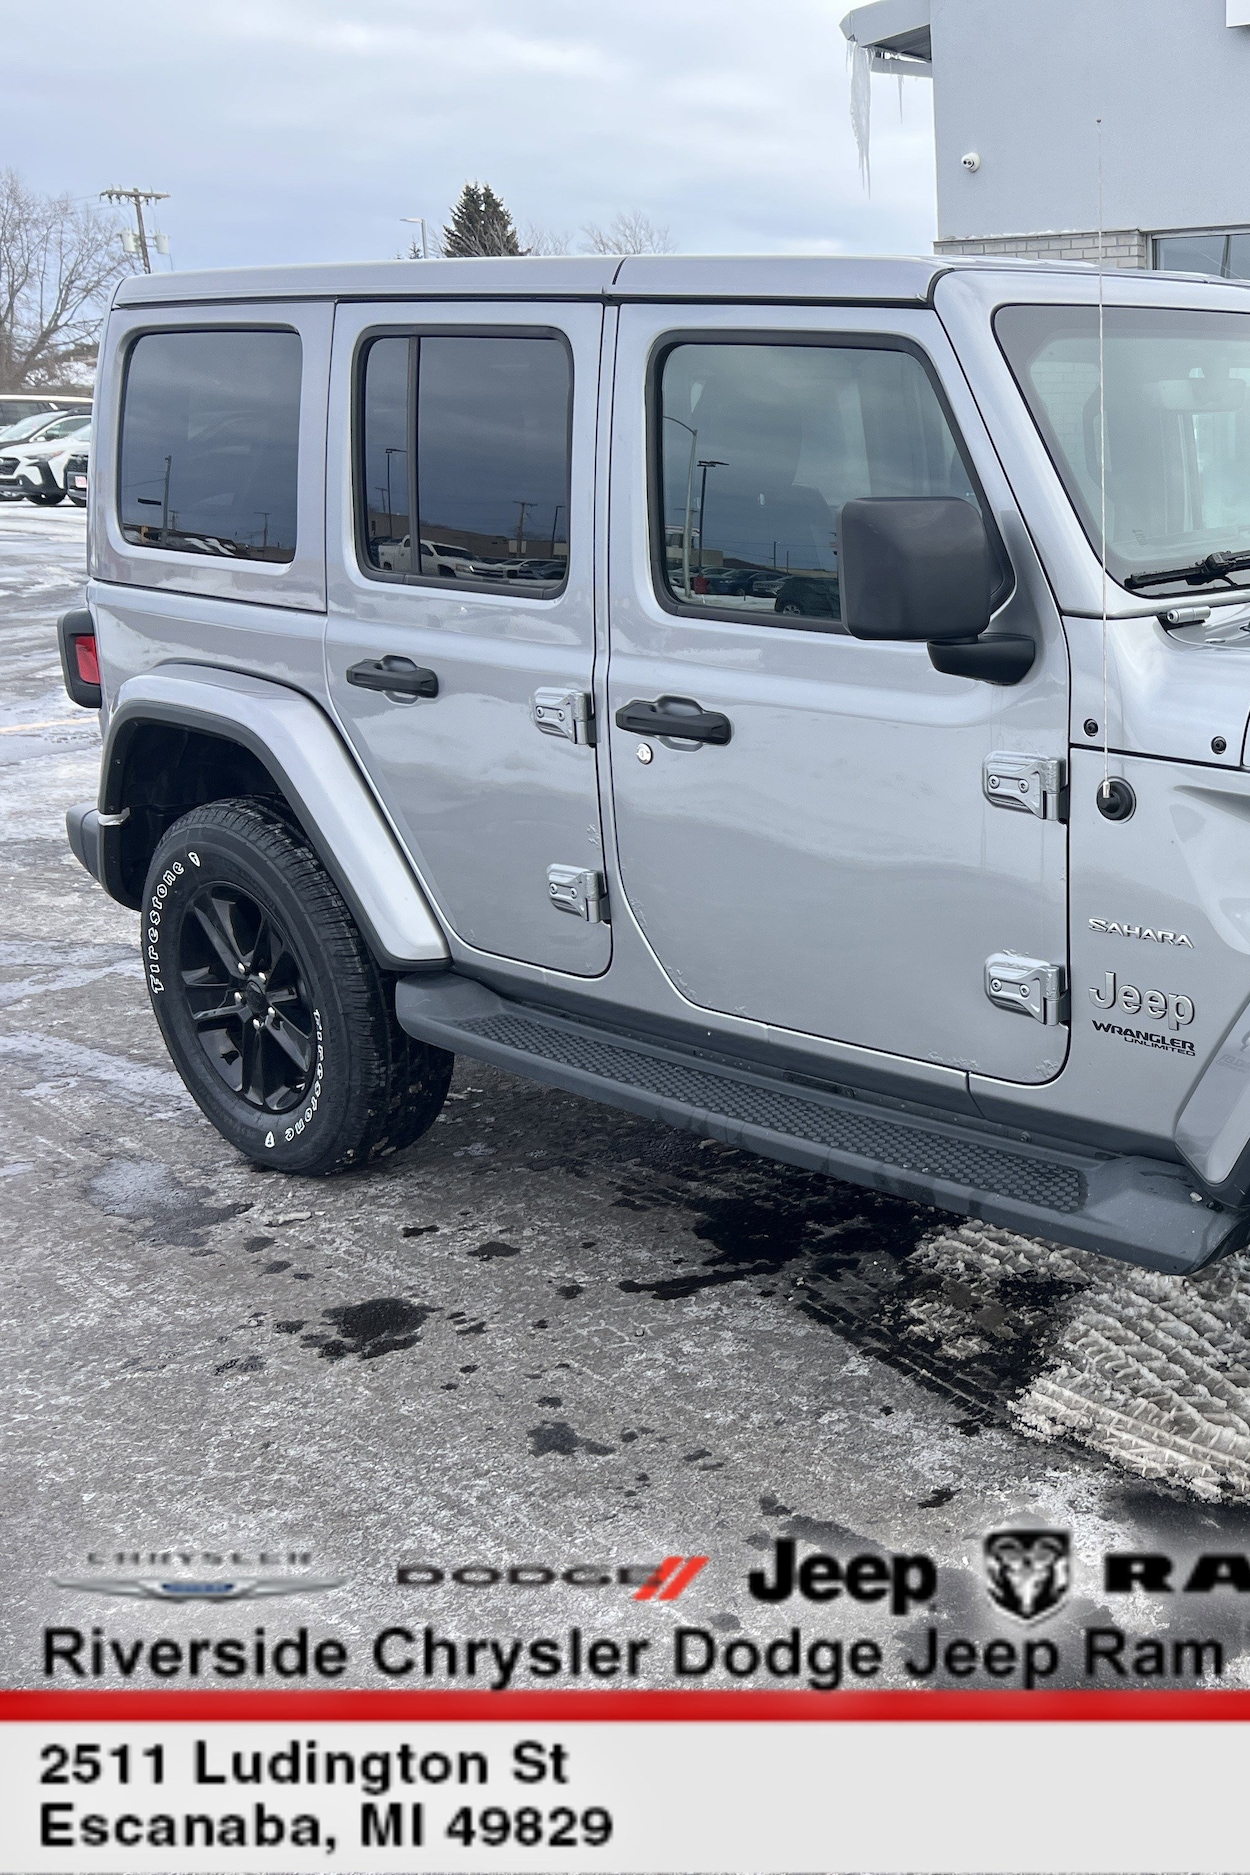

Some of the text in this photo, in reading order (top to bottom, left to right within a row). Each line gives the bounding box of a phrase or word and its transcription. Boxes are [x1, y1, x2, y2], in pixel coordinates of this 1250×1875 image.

[148, 861, 185, 994] Firestone
[1088, 917, 1194, 949] SAHARA
[1088, 970, 1195, 1031] Jeep
[1091, 1019, 1195, 1051] WRANGLER
[1124, 1036, 1196, 1056] UNLIMITED
